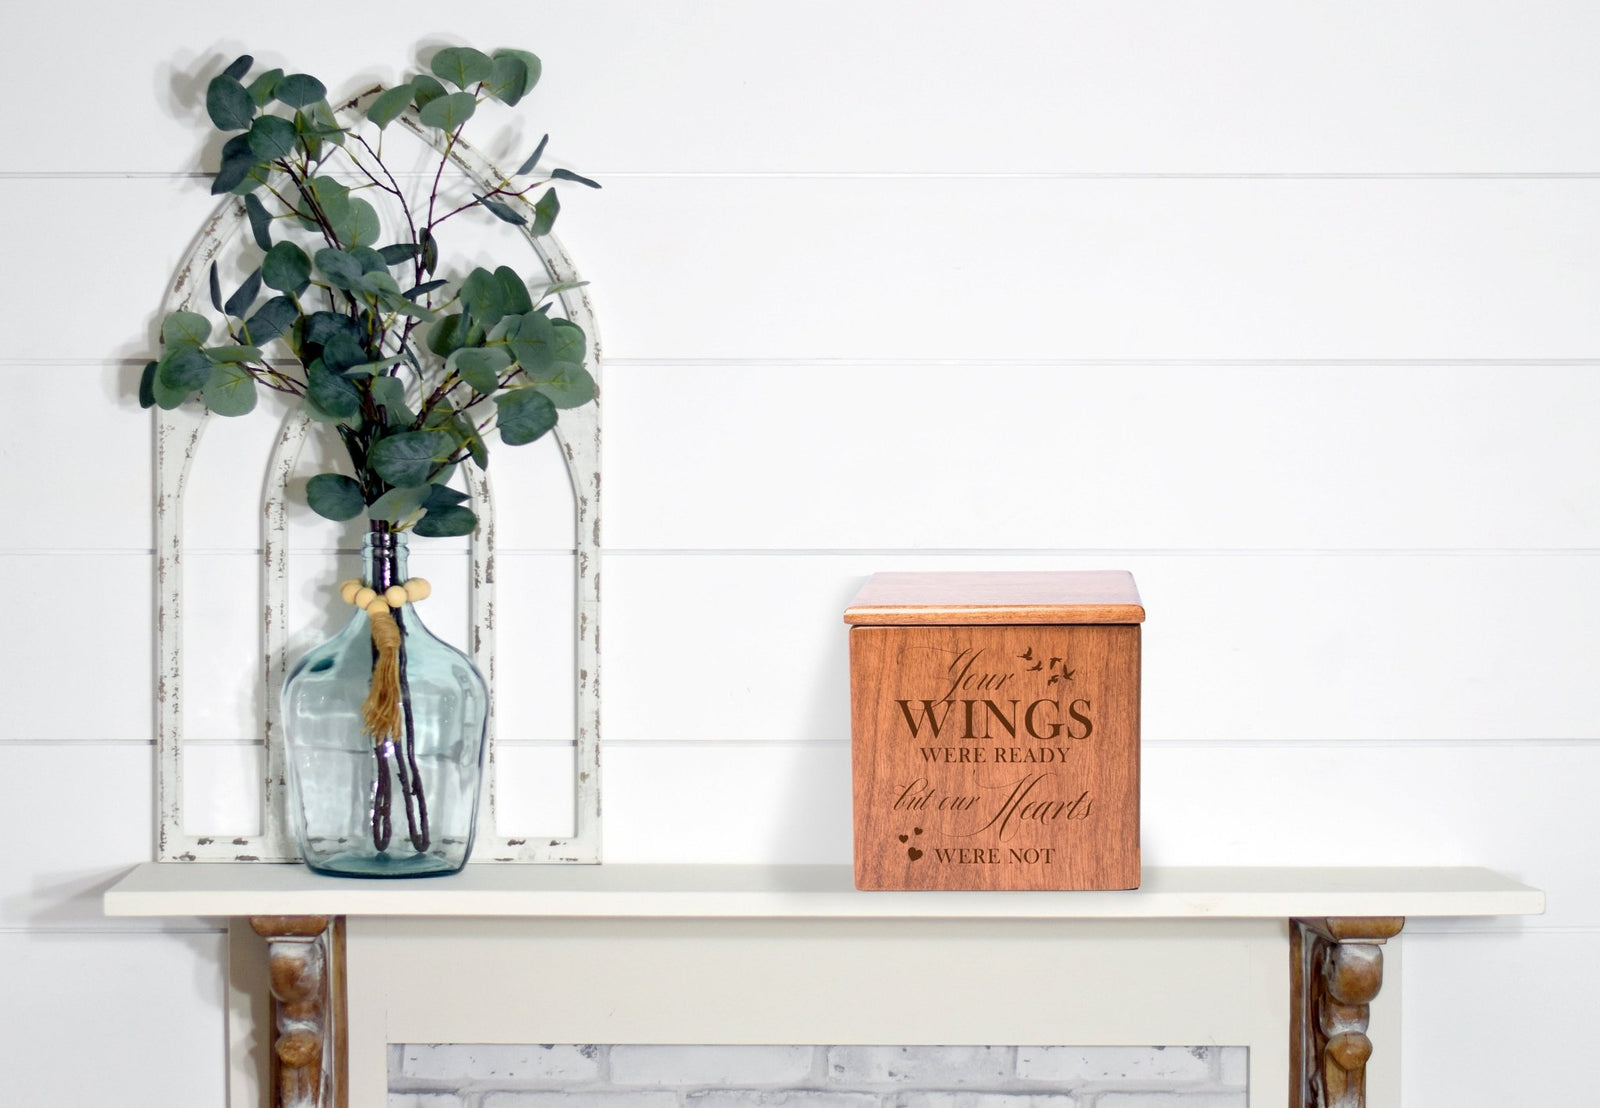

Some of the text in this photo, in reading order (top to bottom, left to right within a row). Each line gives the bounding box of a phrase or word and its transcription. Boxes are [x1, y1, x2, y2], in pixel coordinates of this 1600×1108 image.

[899, 647, 1015, 710] Your
[895, 698, 1093, 740] WINGS
[920, 747, 1071, 764] WERE READY
[893, 772, 1094, 842] but our Hearts
[935, 848, 1056, 865] WERE NOT
